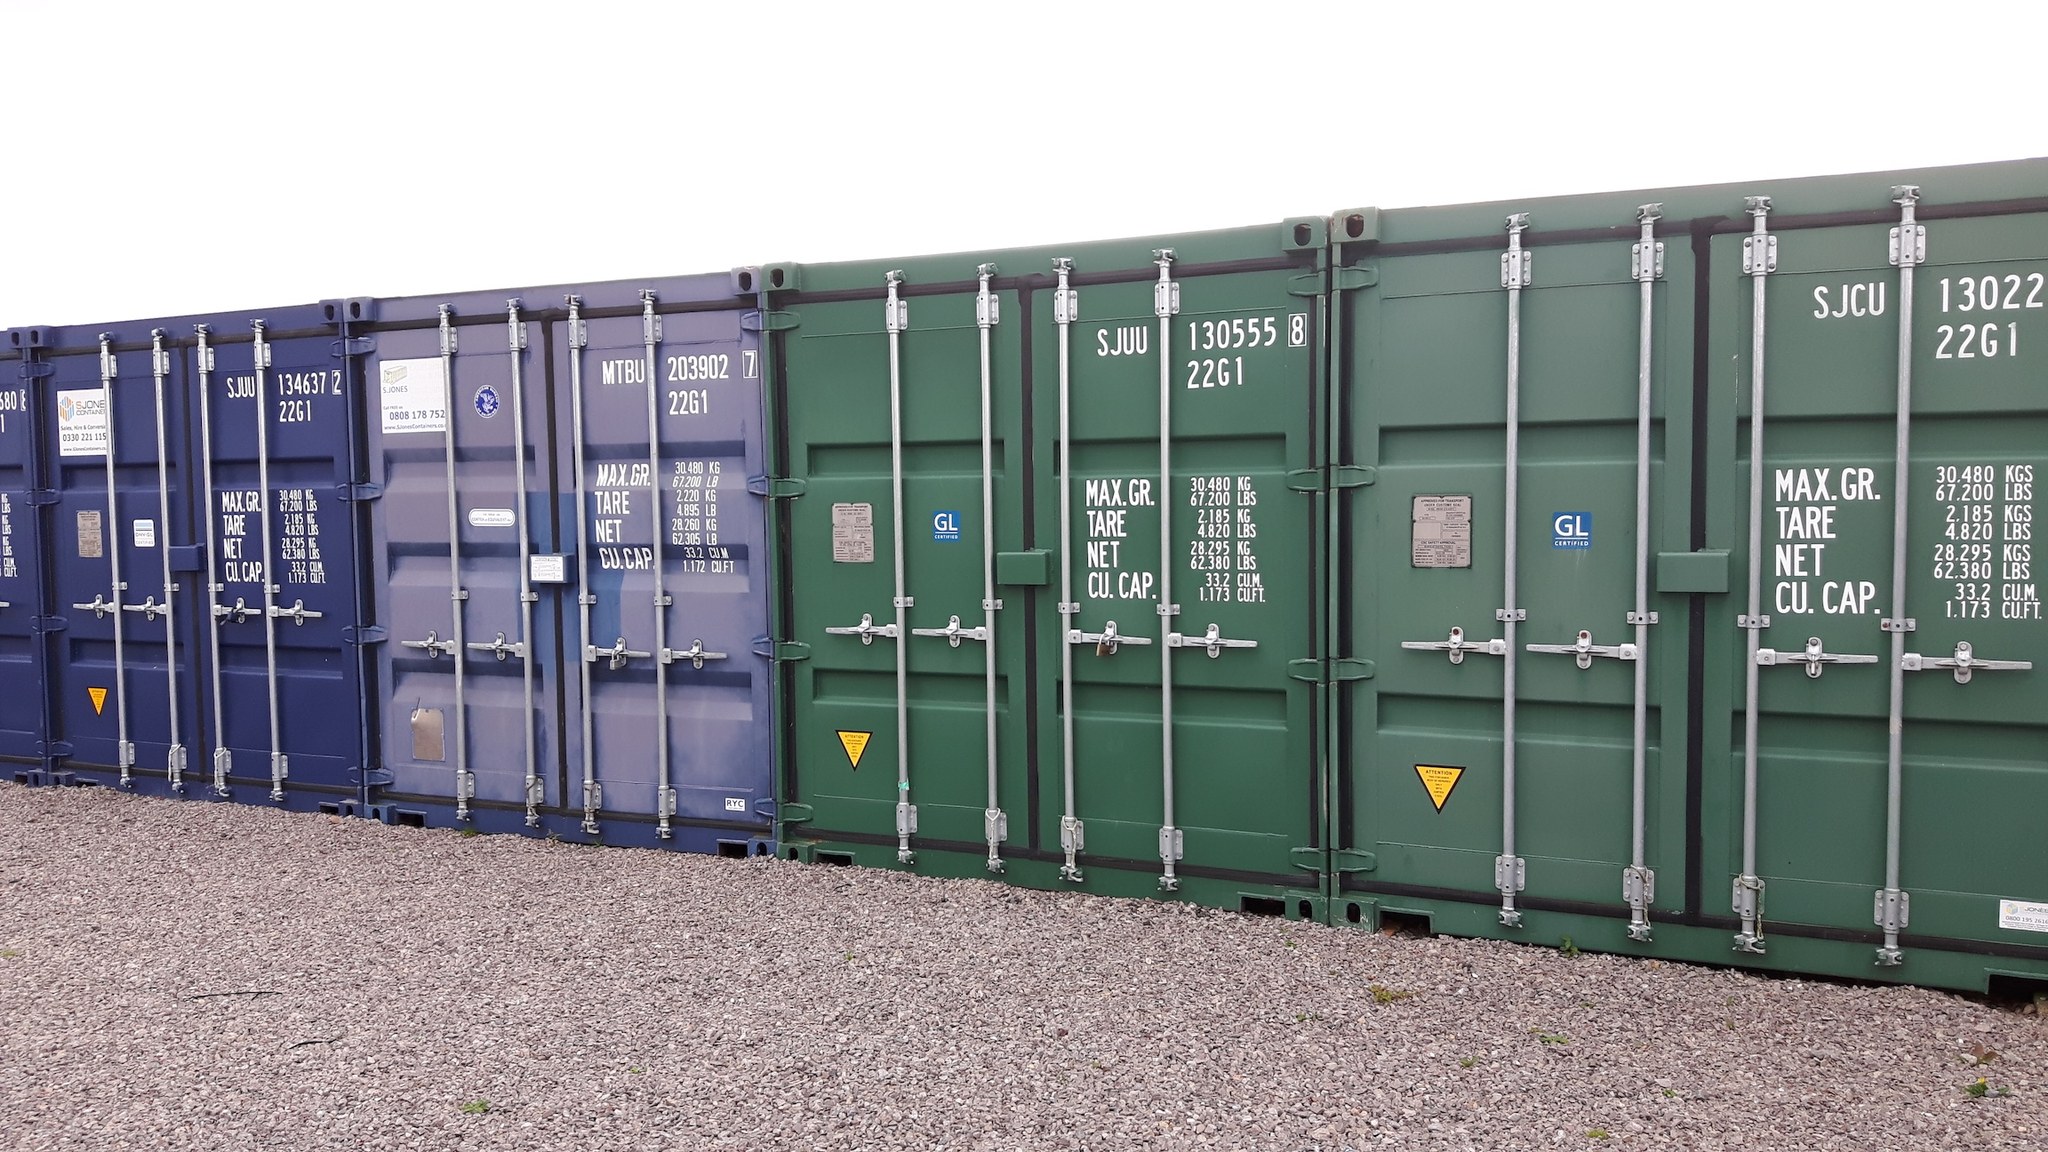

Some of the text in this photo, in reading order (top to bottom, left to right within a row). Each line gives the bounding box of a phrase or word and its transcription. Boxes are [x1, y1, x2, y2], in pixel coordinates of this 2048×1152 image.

[1814, 273, 2044, 319] SJCU 13022
[1097, 316, 1304, 356] SJUU 130555 8
[1936, 322, 2016, 359] 22G1
[602, 352, 755, 384] MTBU 203902 7
[1187, 356, 1242, 388] 22G1
[227, 371, 341, 398] SJUU 134637 2
[280, 400, 310, 422] 22G1
[669, 390, 707, 415] 22G1
[390, 411, 409, 420] 0808
[412, 410, 427, 419] 178
[675, 462, 720, 474] 30.480 KG
[2005, 465, 2033, 482] KGS
[673, 476, 718, 488] 67.200 LB
[1237, 476, 1250, 491] KG
[305, 489, 313, 500] KG
[706, 490, 716, 502] KG
[1237, 491, 1256, 506] LBS
[2005, 484, 2032, 500] LBS
[306, 500, 317, 511] LBS
[595, 491, 630, 514] TARE
[677, 504, 716, 516] 4.895 LB
[307, 514, 315, 524] KG
[1237, 509, 1250, 523] KG
[2004, 505, 2032, 522] KGS
[223, 515, 246, 535] TARE
[308, 524, 319, 535] LBS
[596, 520, 622, 542] NET
[706, 519, 716, 531] KG
[934, 514, 958, 531] GL
[1087, 510, 1127, 537] TARE
[1237, 524, 1256, 538] LBS
[1555, 515, 1588, 536] GL
[1776, 506, 1836, 539] TARE
[672, 533, 717, 545] 62.305 LB
[2004, 523, 2031, 540] LBS
[224, 538, 242, 558] NET
[308, 538, 316, 548] KG
[1237, 541, 1250, 555] KG
[309, 549, 320, 559] LBS
[684, 547, 704, 558] 33.2
[1087, 541, 1120, 568] NET
[1776, 544, 1824, 576] NET
[2004, 544, 2031, 561] KGS
[292, 562, 306, 572] 33.2
[683, 560, 705, 572] 1.172
[1237, 556, 1256, 570] LBS
[2003, 562, 2030, 580] LBS
[242, 562, 264, 582] CAP.
[1206, 573, 1230, 587] 33.2
[1088, 572, 1156, 599] CU. CAP.
[1955, 583, 1990, 600] 33.2
[1776, 581, 1880, 614] CU. CAP.
